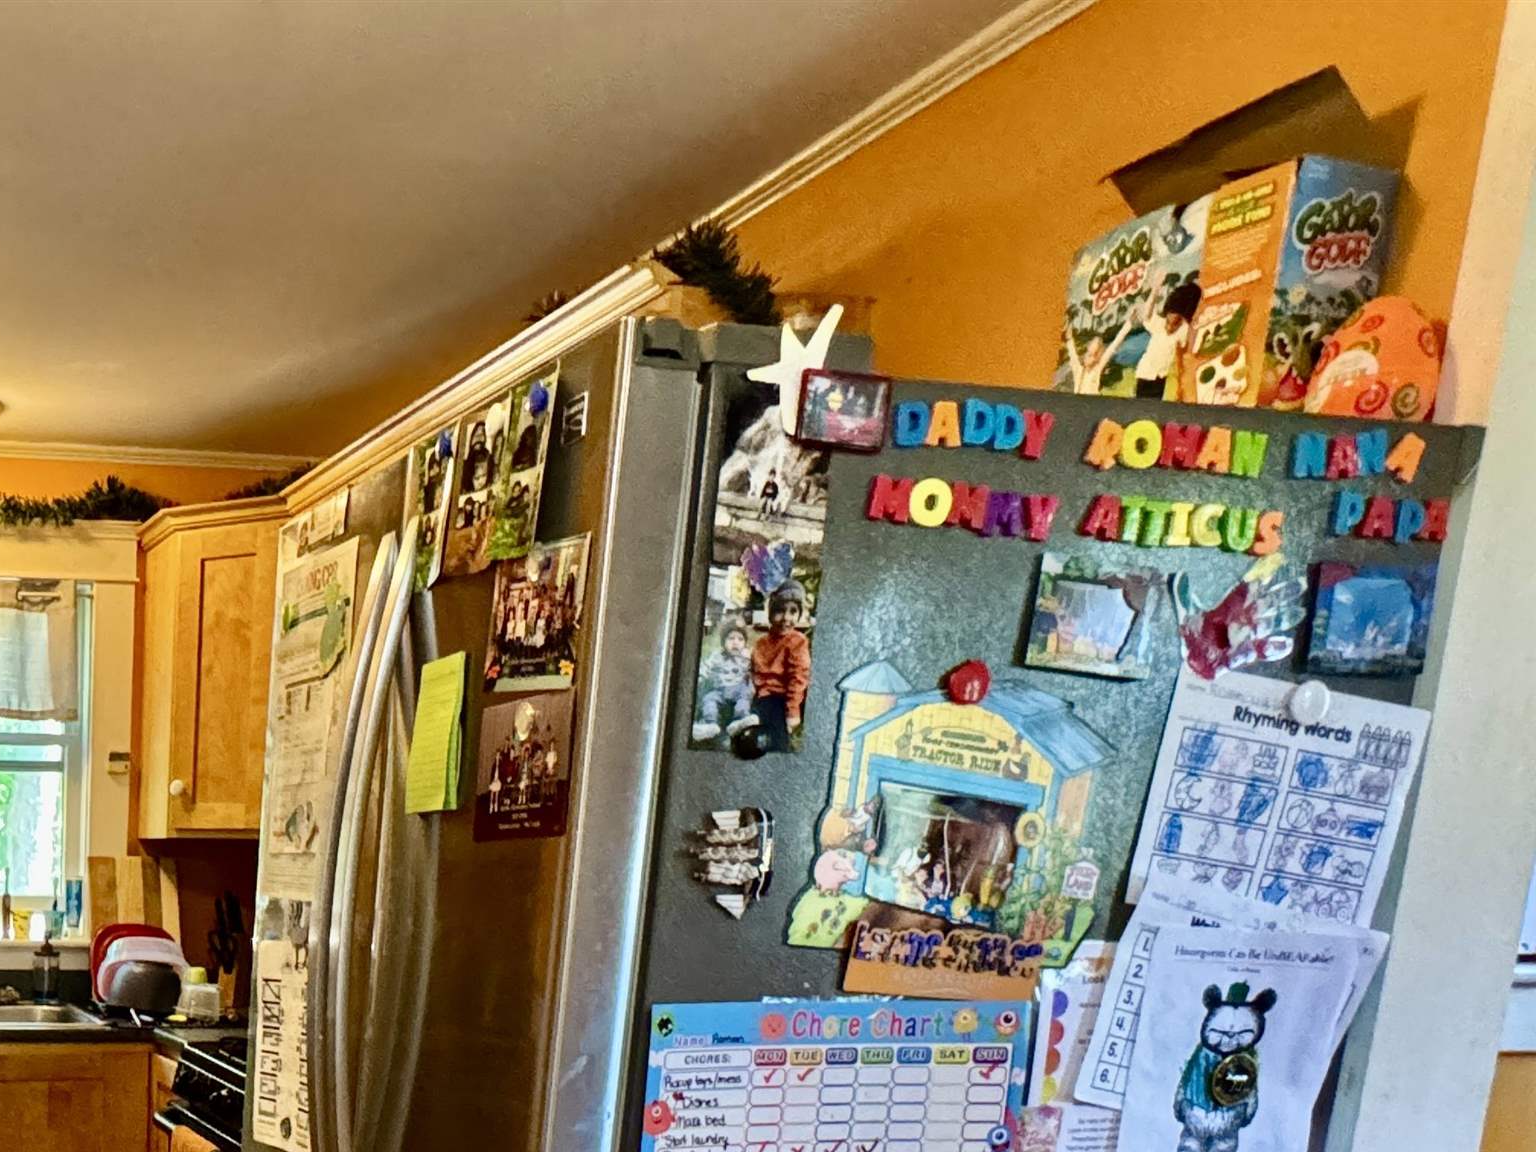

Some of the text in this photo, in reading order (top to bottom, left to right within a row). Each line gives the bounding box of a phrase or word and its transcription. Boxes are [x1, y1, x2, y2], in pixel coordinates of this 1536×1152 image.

[1297, 192, 1380, 243] GATOR
[1088, 231, 1152, 294] GATOR
[1306, 234, 1369, 270] GOLF
[1095, 264, 1146, 310] GOLF
[894, 398, 1426, 484] DADDY ROMAN NANA
[868, 474, 1448, 556] MOMMY ATTICUS PAPA
[1233, 705, 1352, 743] Rhyming words
[792, 1009, 944, 1039] Chore Chart
[684, 1054, 731, 1065] CHORES:
[793, 1050, 818, 1061] TUE
[827, 1049, 854, 1061] WED
[864, 1050, 890, 1061] THU
[900, 1049, 927, 1061] FRI
[939, 1049, 965, 1060] SAT
[977, 1048, 1006, 1060] SUN
[704, 1114, 726, 1126] bed
